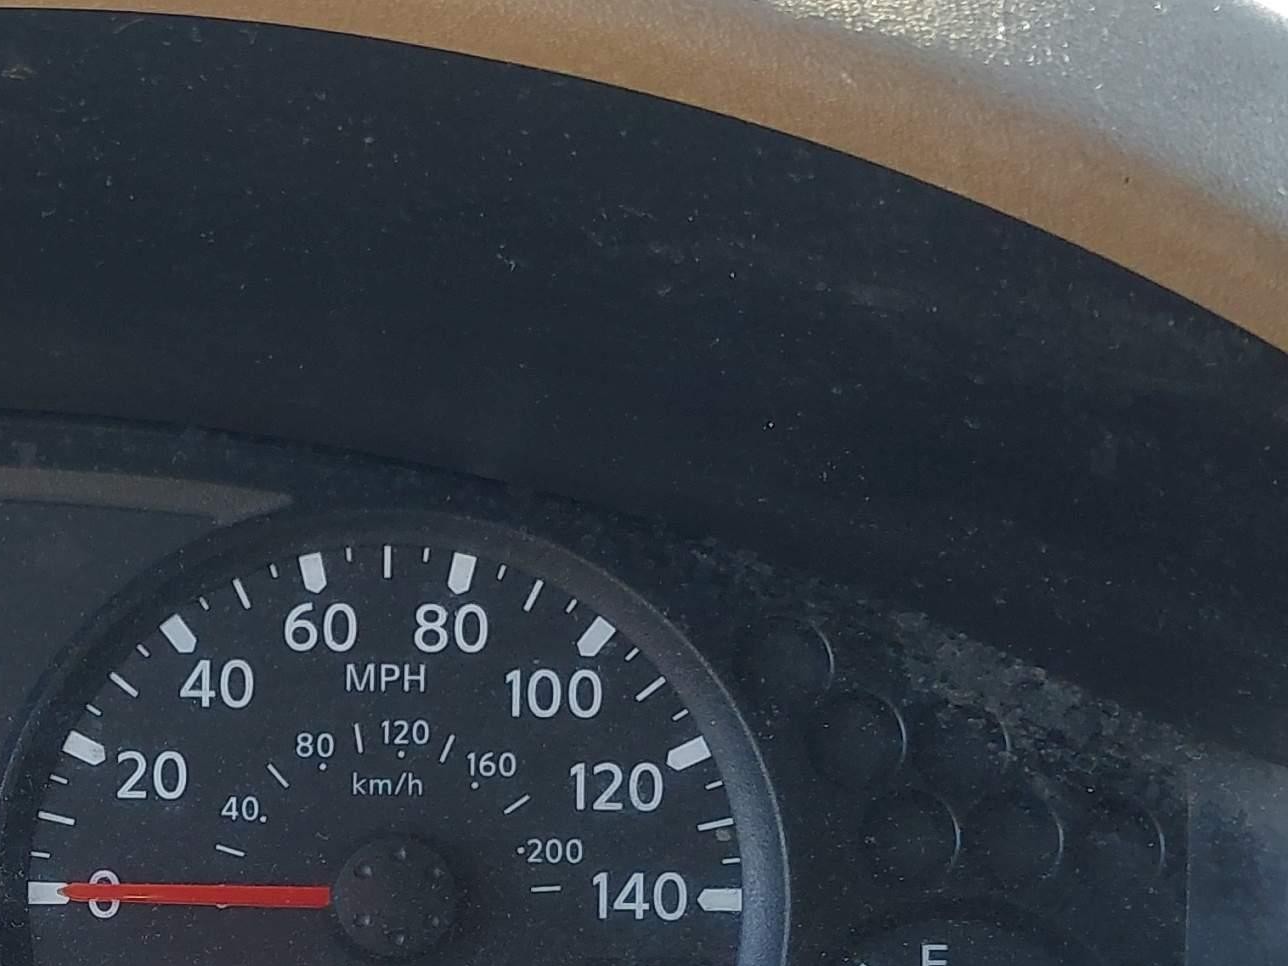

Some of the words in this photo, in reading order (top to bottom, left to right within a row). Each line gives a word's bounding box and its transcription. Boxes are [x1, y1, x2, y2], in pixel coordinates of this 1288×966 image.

[284, 603, 357, 653] 60
[414, 603, 488, 653] 80
[180, 659, 254, 708] 40
[345, 664, 426, 693] MPH
[505, 669, 602, 718] 100
[296, 732, 335, 758] 80
[381, 720, 429, 746] 120
[117, 751, 187, 800] 20
[352, 772, 424, 798] km/h
[466, 753, 516, 777] 160
[570, 762, 663, 812] 120
[88, 870, 121, 919] 0
[591, 872, 688, 921] 140
